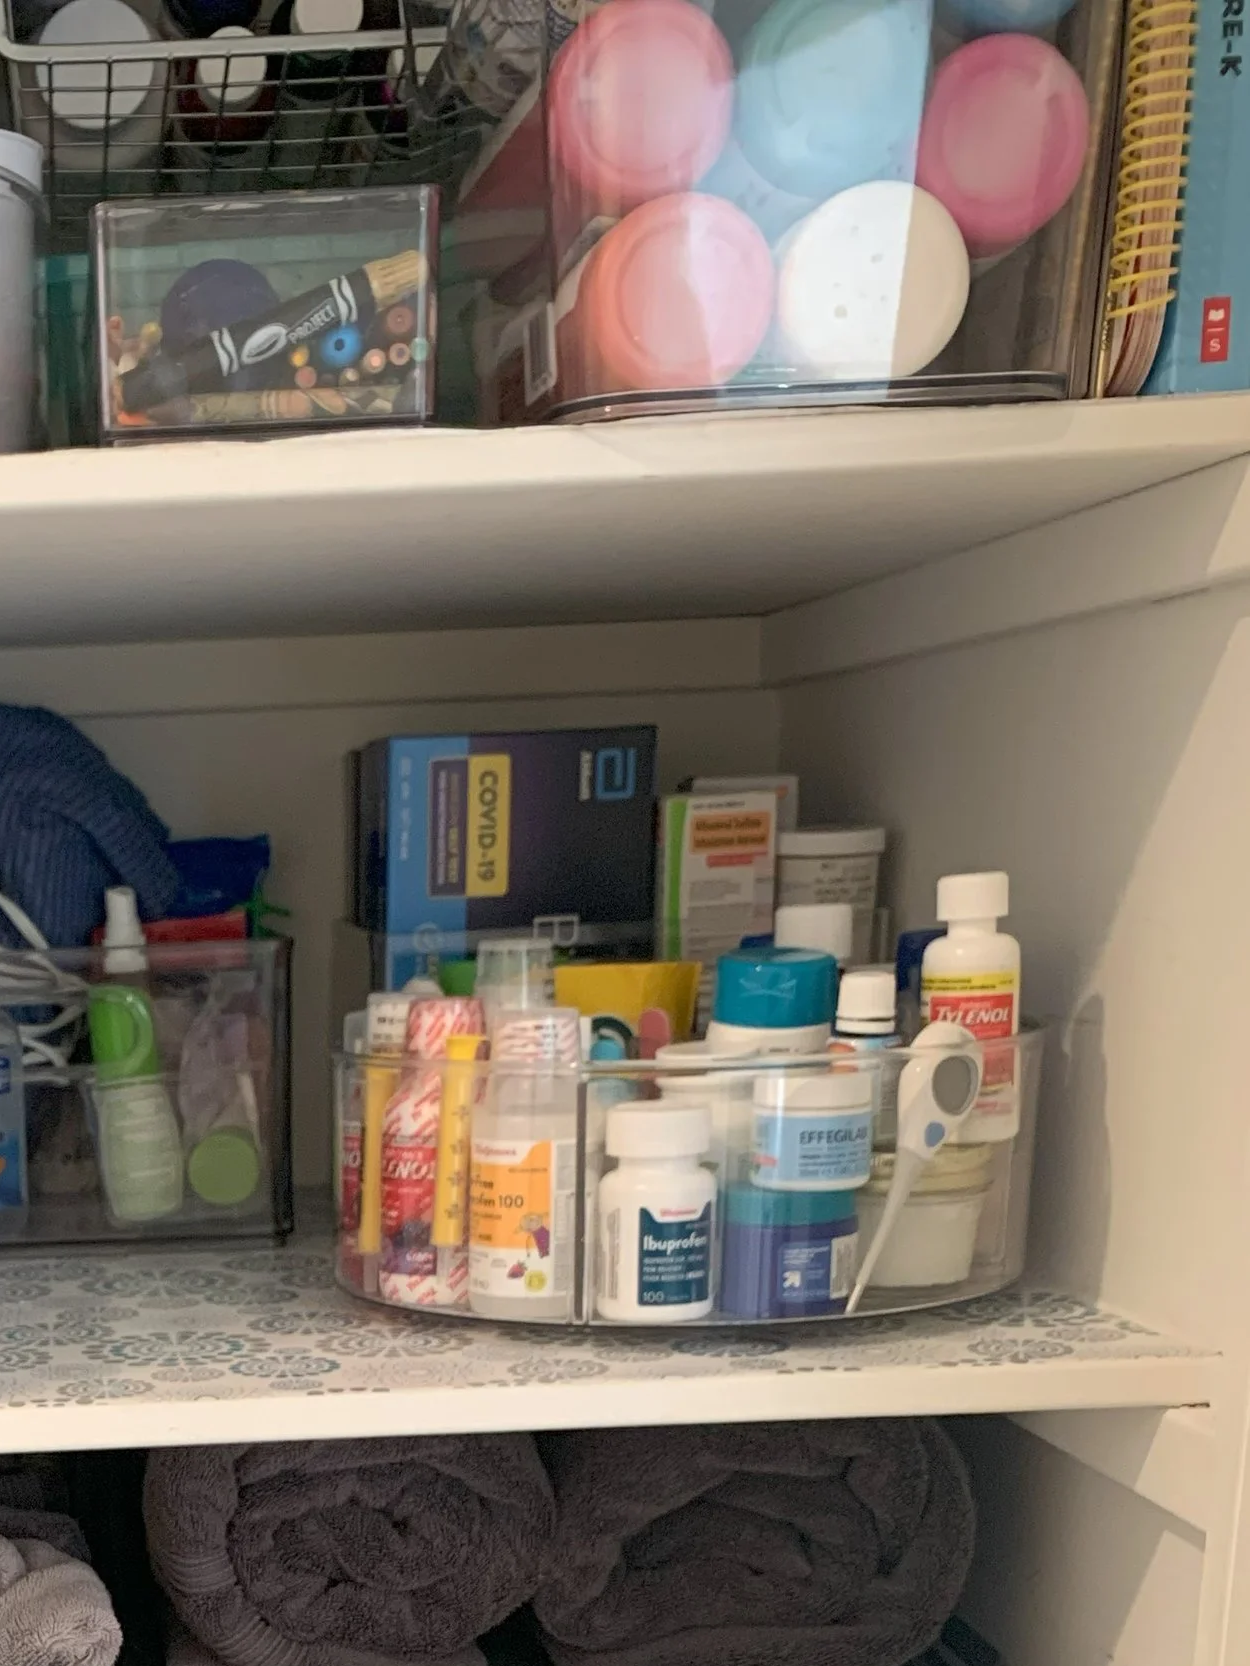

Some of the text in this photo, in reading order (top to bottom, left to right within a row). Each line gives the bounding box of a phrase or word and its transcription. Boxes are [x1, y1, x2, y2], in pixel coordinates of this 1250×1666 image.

[478, 770, 499, 883] COVID-19
[935, 1005, 1010, 1026] TYLENOL
[498, 1194, 525, 1209] 100
[643, 1231, 707, 1256] Ibuprofen
